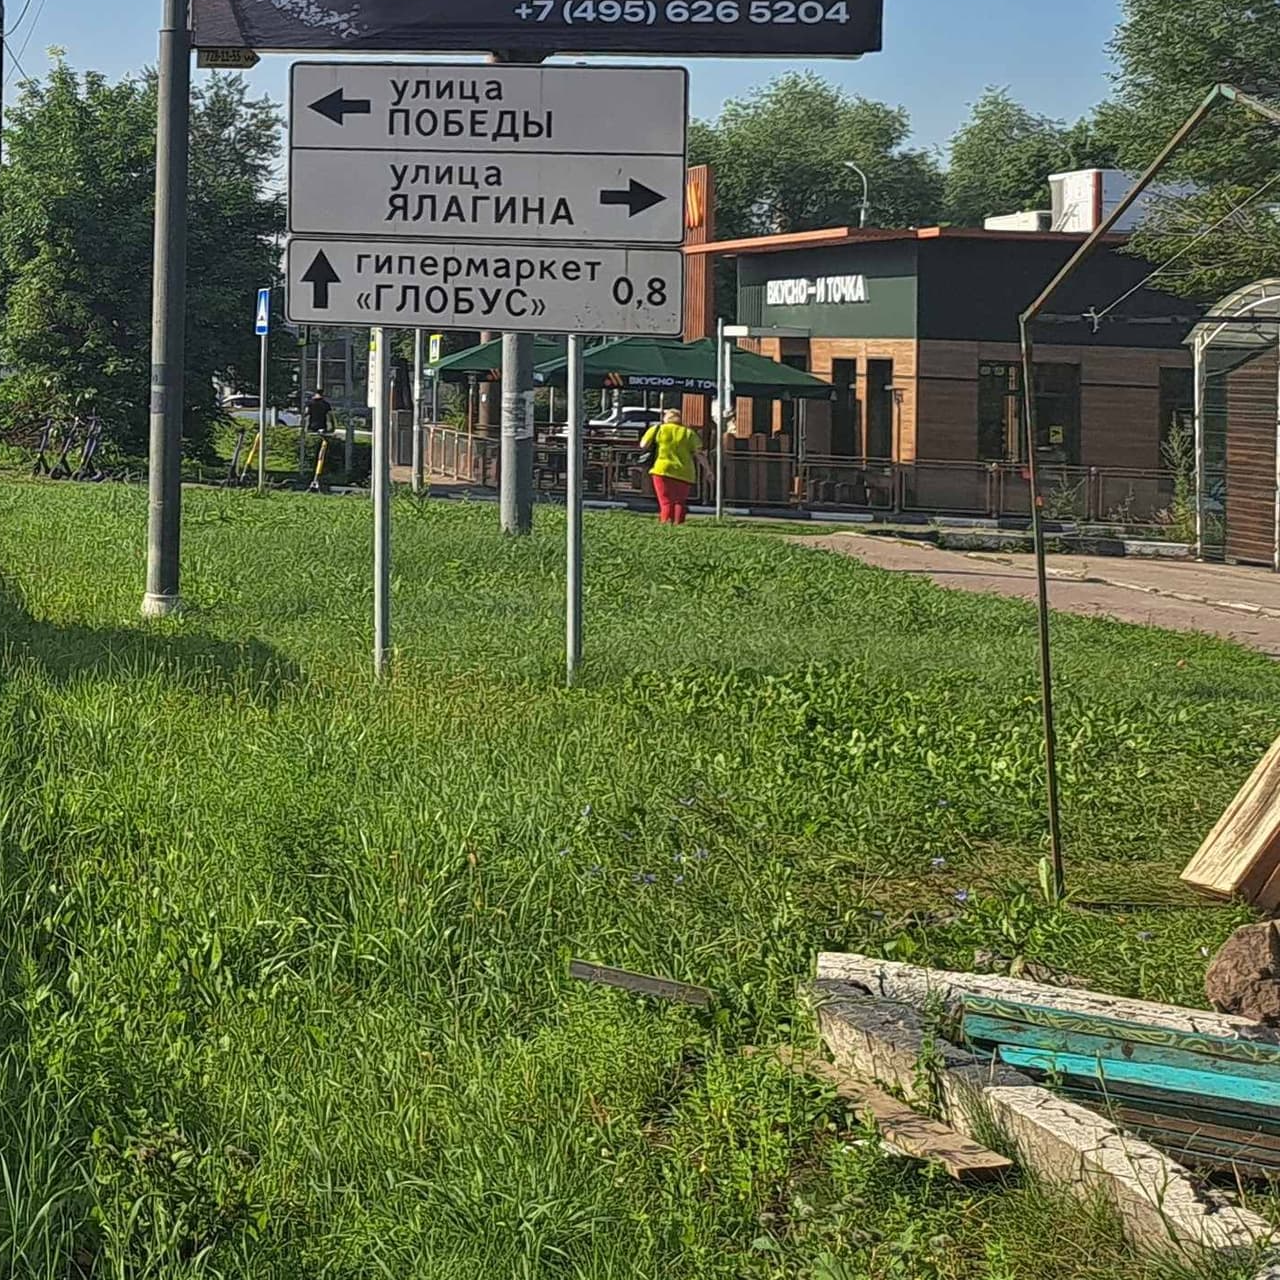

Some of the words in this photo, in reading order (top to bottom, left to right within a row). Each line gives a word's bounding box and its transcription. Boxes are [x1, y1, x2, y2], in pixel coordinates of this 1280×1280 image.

[514, 0, 554, 22] +7
[562, 0, 657, 24] (495)
[665, 0, 740, 23] 626
[748, 1, 850, 23] 5204
[389, 79, 504, 106] улица
[388, 108, 553, 142] ПОБЕДЫ
[389, 164, 503, 191] улица
[385, 193, 574, 225] ЯЛАГИНА
[356, 253, 602, 286] гипермаркет
[356, 284, 546, 317] «ГЛОБУС»
[612, 276, 668, 310] 0,8
